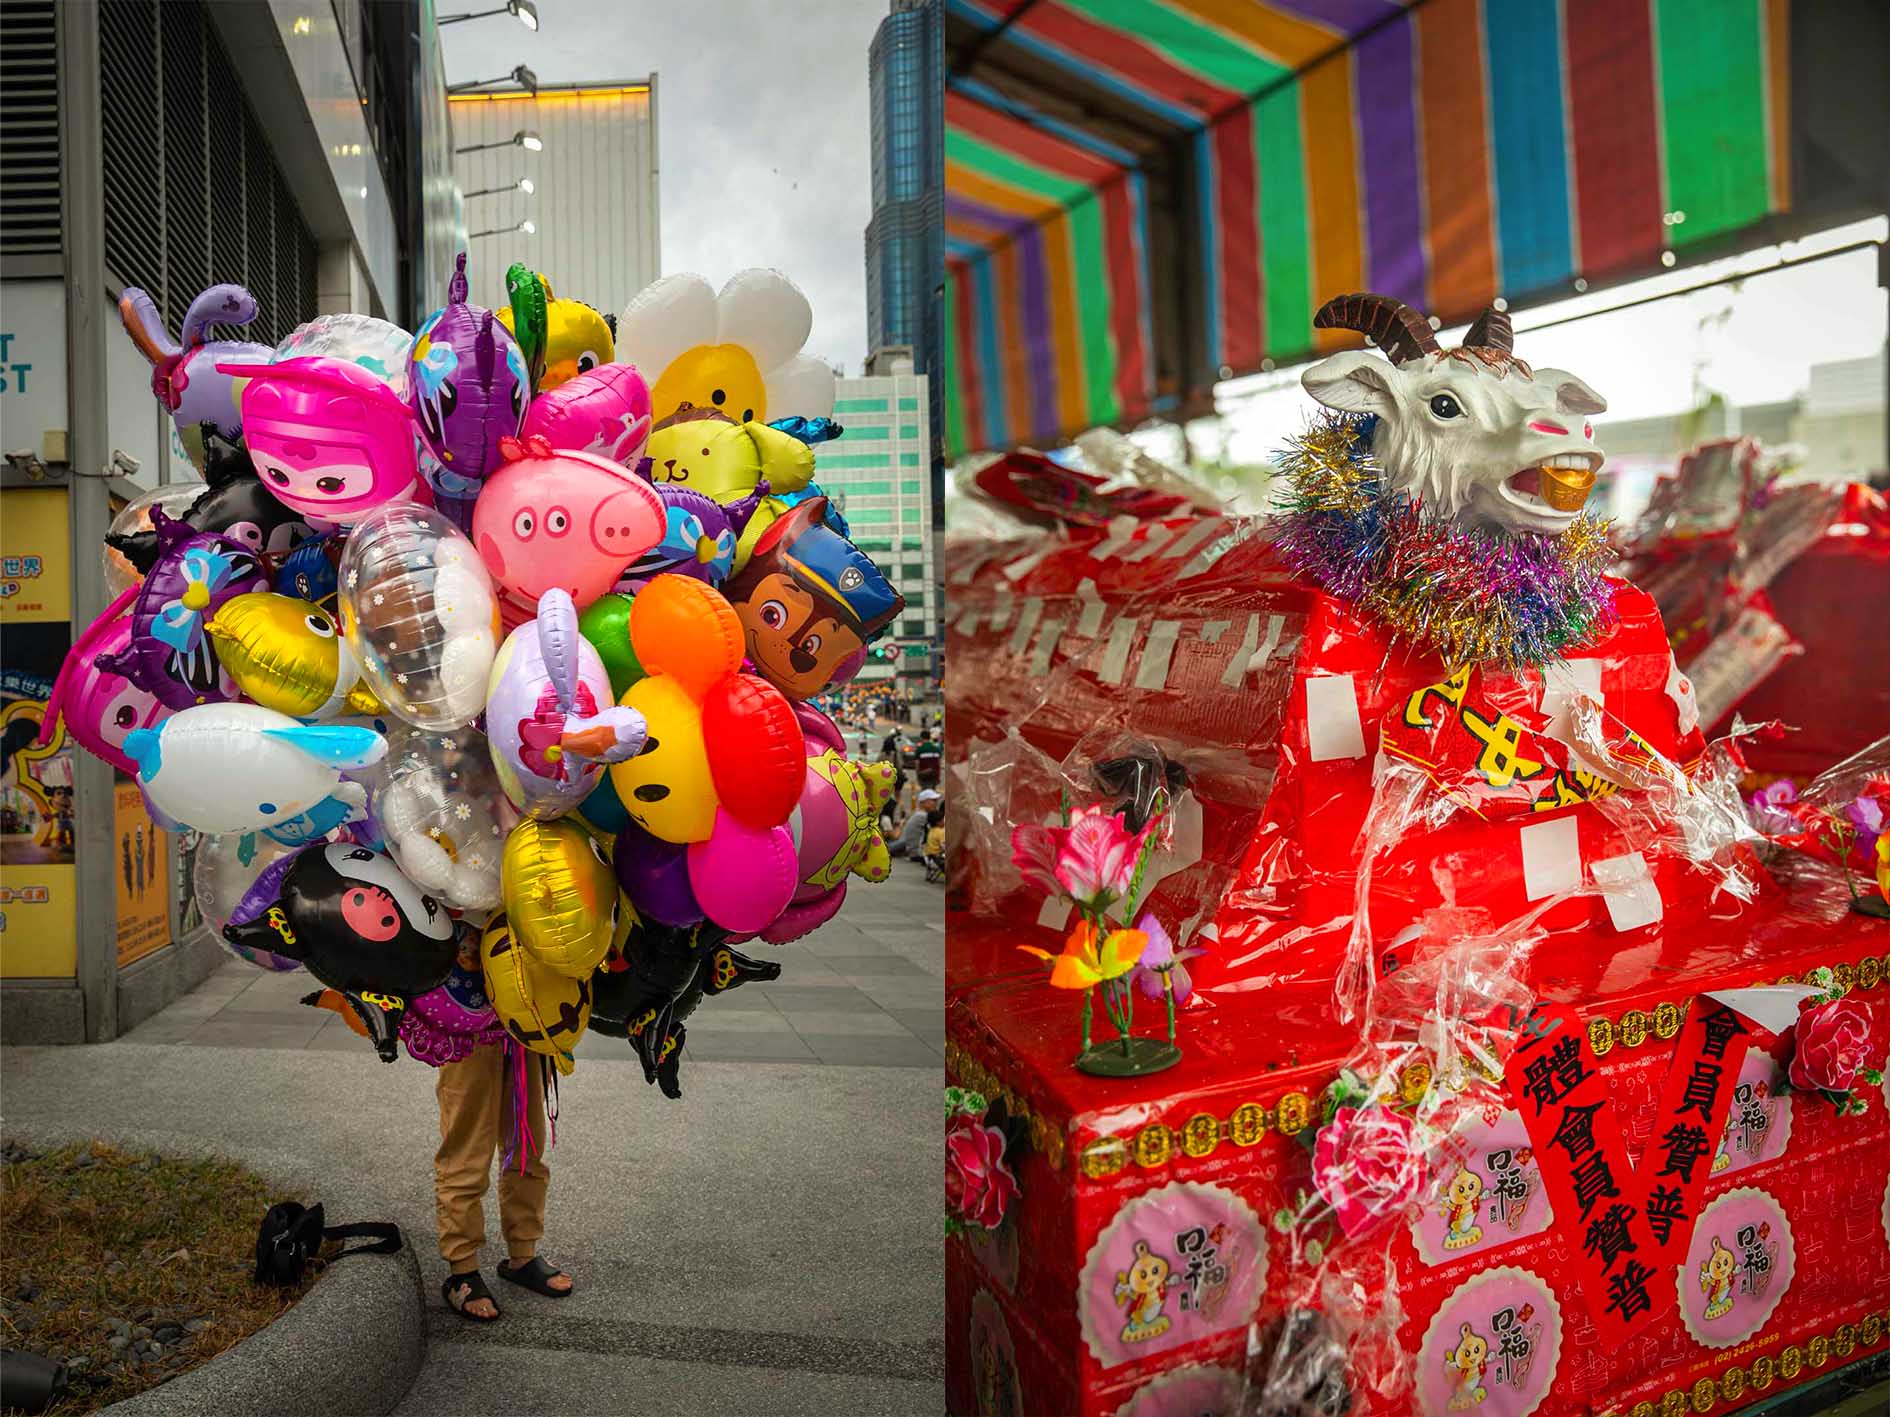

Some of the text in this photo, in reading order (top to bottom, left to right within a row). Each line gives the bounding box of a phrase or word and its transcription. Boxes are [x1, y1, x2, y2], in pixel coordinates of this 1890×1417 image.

[1646, 1007, 1748, 1246] 會員贊普
[1487, 1149, 1527, 1221] 口福
[1737, 1226, 1768, 1289] 口福
[1492, 1308, 1530, 1380] 口福
